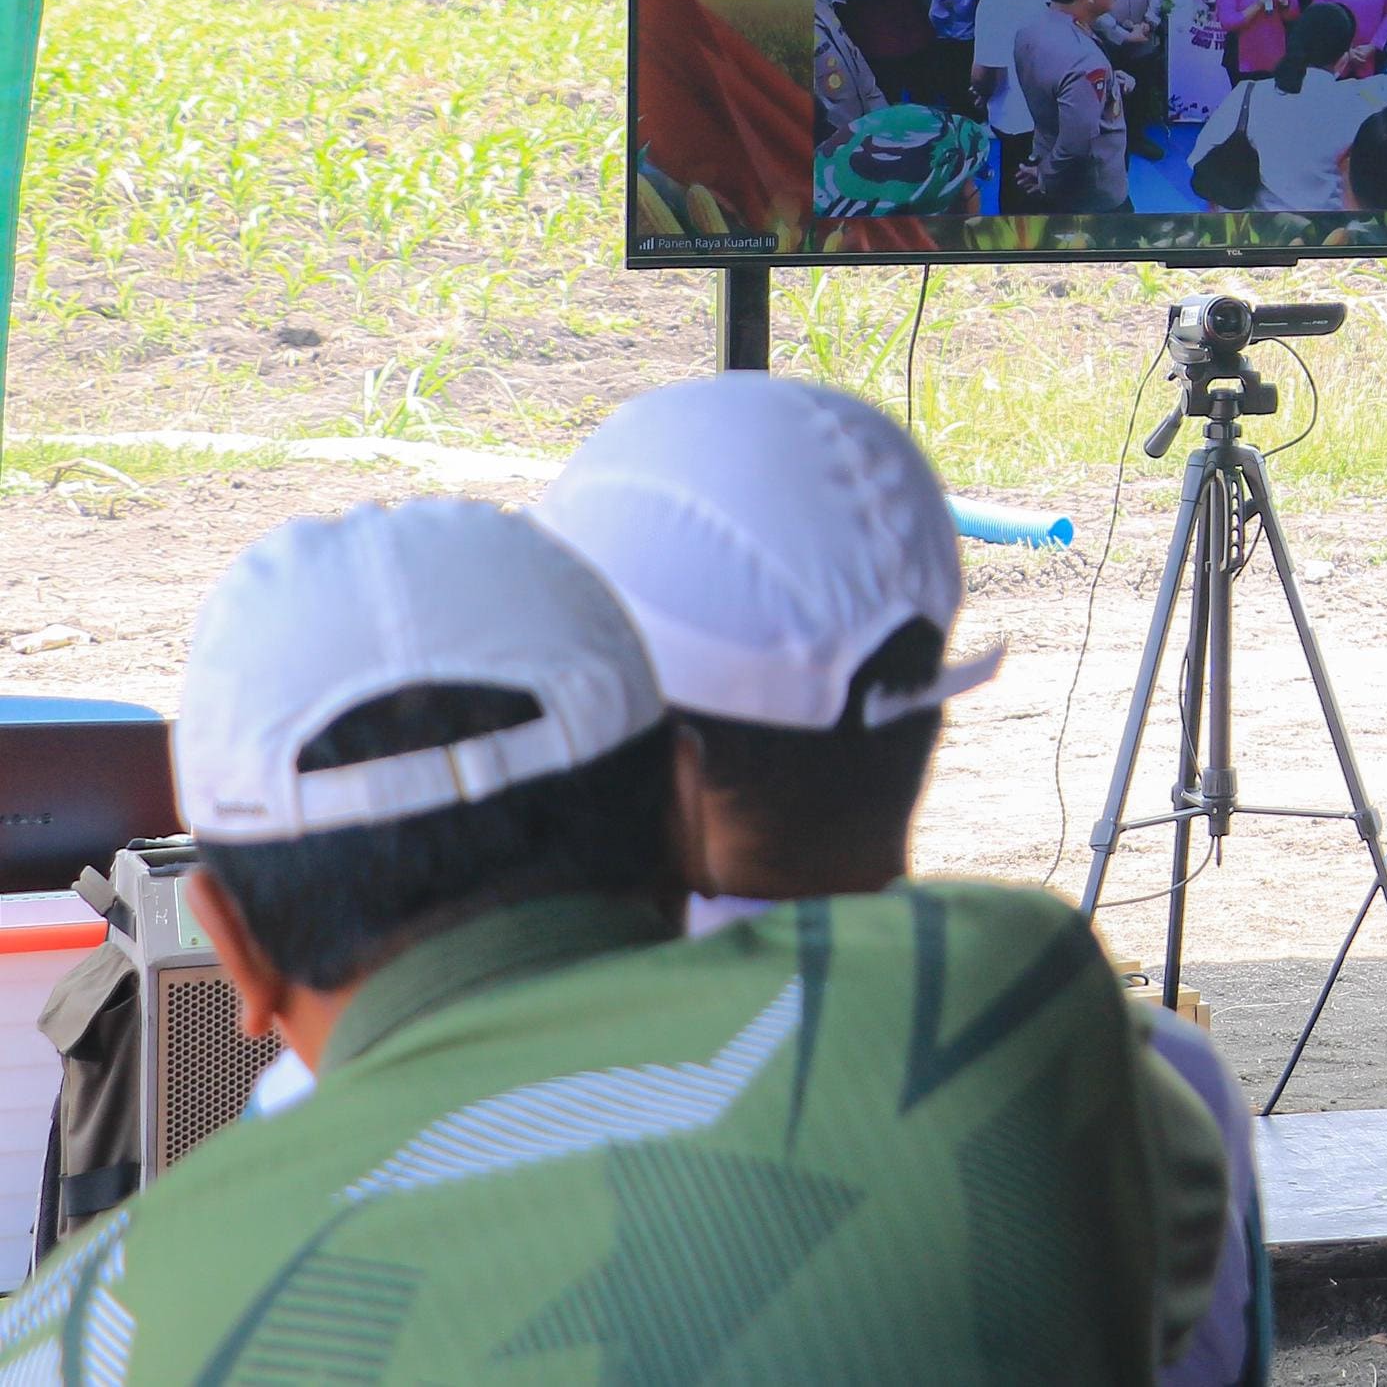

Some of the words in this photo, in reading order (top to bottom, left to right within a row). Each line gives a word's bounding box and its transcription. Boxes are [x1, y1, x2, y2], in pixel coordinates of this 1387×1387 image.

[658, 238, 692, 249] Panen
[695, 238, 720, 250] Raya
[724, 236, 762, 248] Kuartal
[765, 237, 775, 247] III
